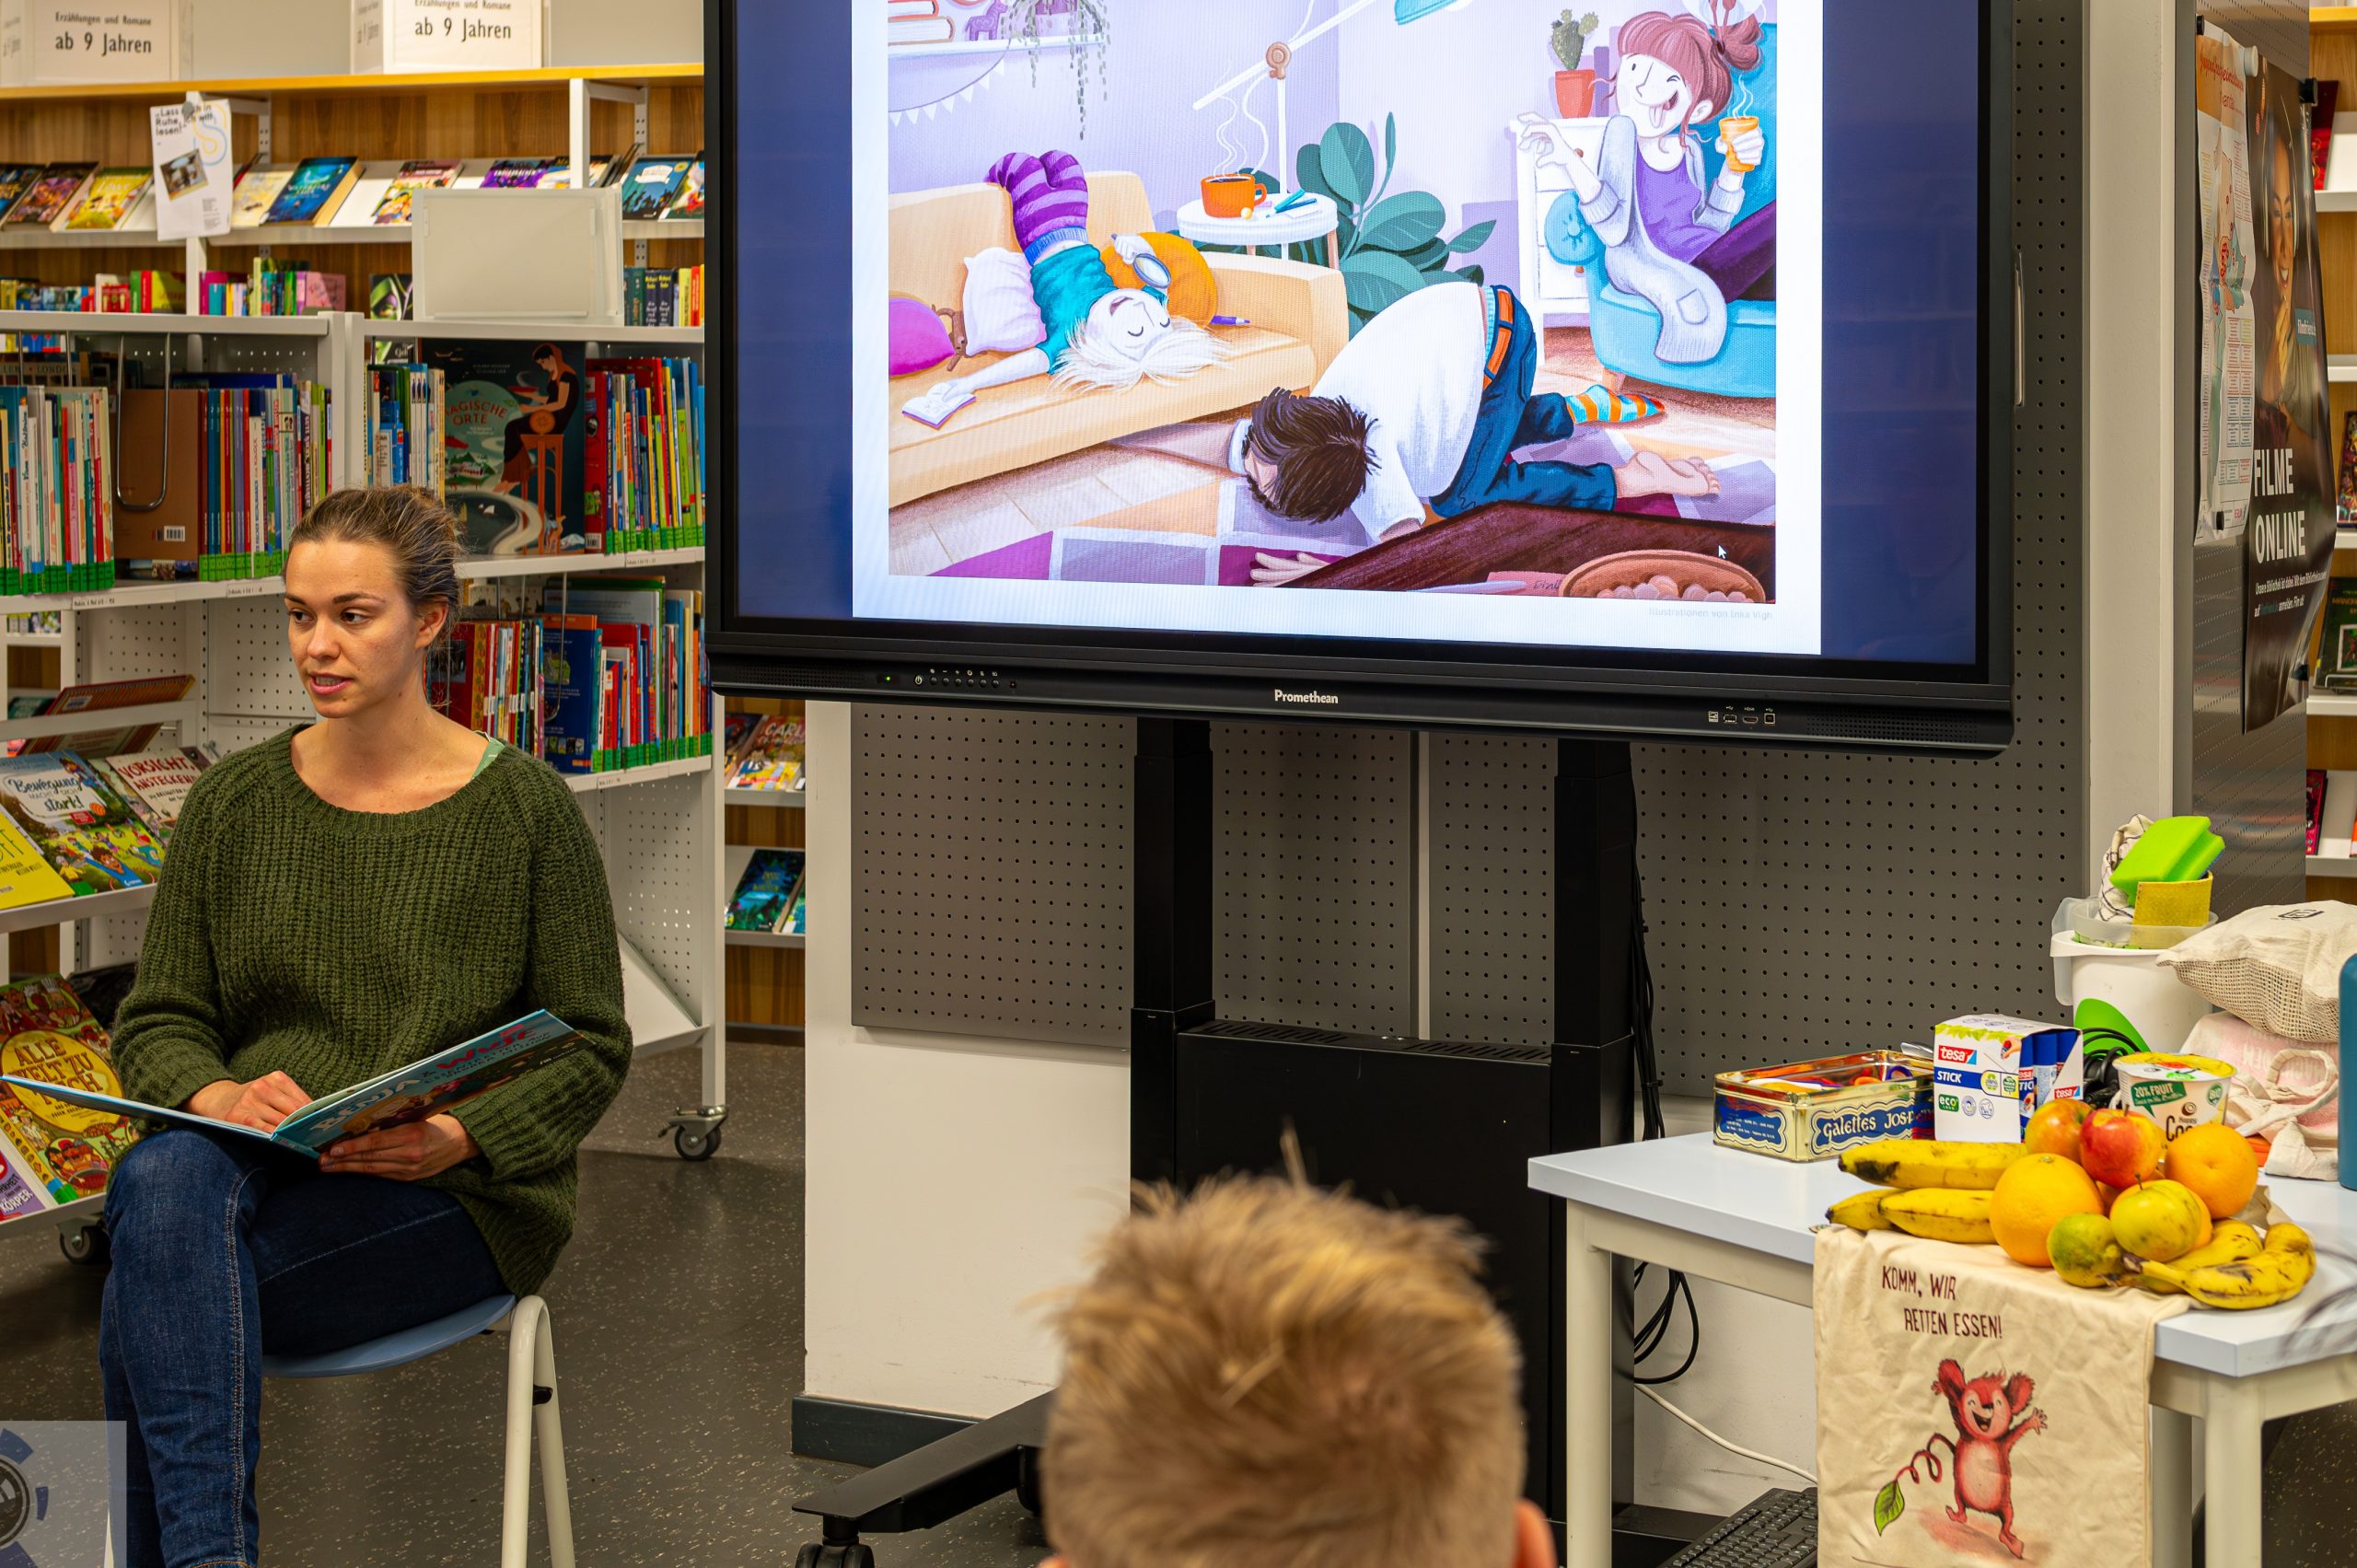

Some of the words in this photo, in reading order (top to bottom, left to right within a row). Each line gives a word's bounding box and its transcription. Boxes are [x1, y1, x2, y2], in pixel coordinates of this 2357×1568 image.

[55, 11, 100, 25] Erzählungen
[104, 15, 119, 25] und
[122, 15, 151, 26] Romane
[414, 17, 434, 36] ab
[444, 17, 452, 37] 9
[461, 18, 511, 42] Jahren
[55, 31, 74, 50] ab
[84, 31, 93, 52] 9
[101, 32, 152, 57] Jahren
[453, 412, 488, 426] ORTE
[2254, 448, 2294, 496] FILME
[2256, 510, 2305, 563] ONLINE
[1649, 608, 1710, 619] Illustrationen
[1712, 610, 1728, 619] von
[1274, 689, 1339, 704] Promethean
[7, 777, 83, 794] Bewegung
[14, 1037, 66, 1067] ALLE
[1940, 1046, 1966, 1062] tesa
[64, 1051, 94, 1075] ZU
[1937, 1070, 1963, 1084] STICK
[2055, 1088, 2073, 1098] tesa
[2150, 1083, 2173, 1097] FRUIT
[1939, 1096, 1957, 1108] eco
[1823, 1114, 1876, 1143] Galettes
[1882, 1265, 1922, 1298] KOMM,
[1930, 1272, 1956, 1301] WIR
[1903, 1307, 1948, 1335] RETTEN
[1953, 1312, 2003, 1339] ESSEN!
